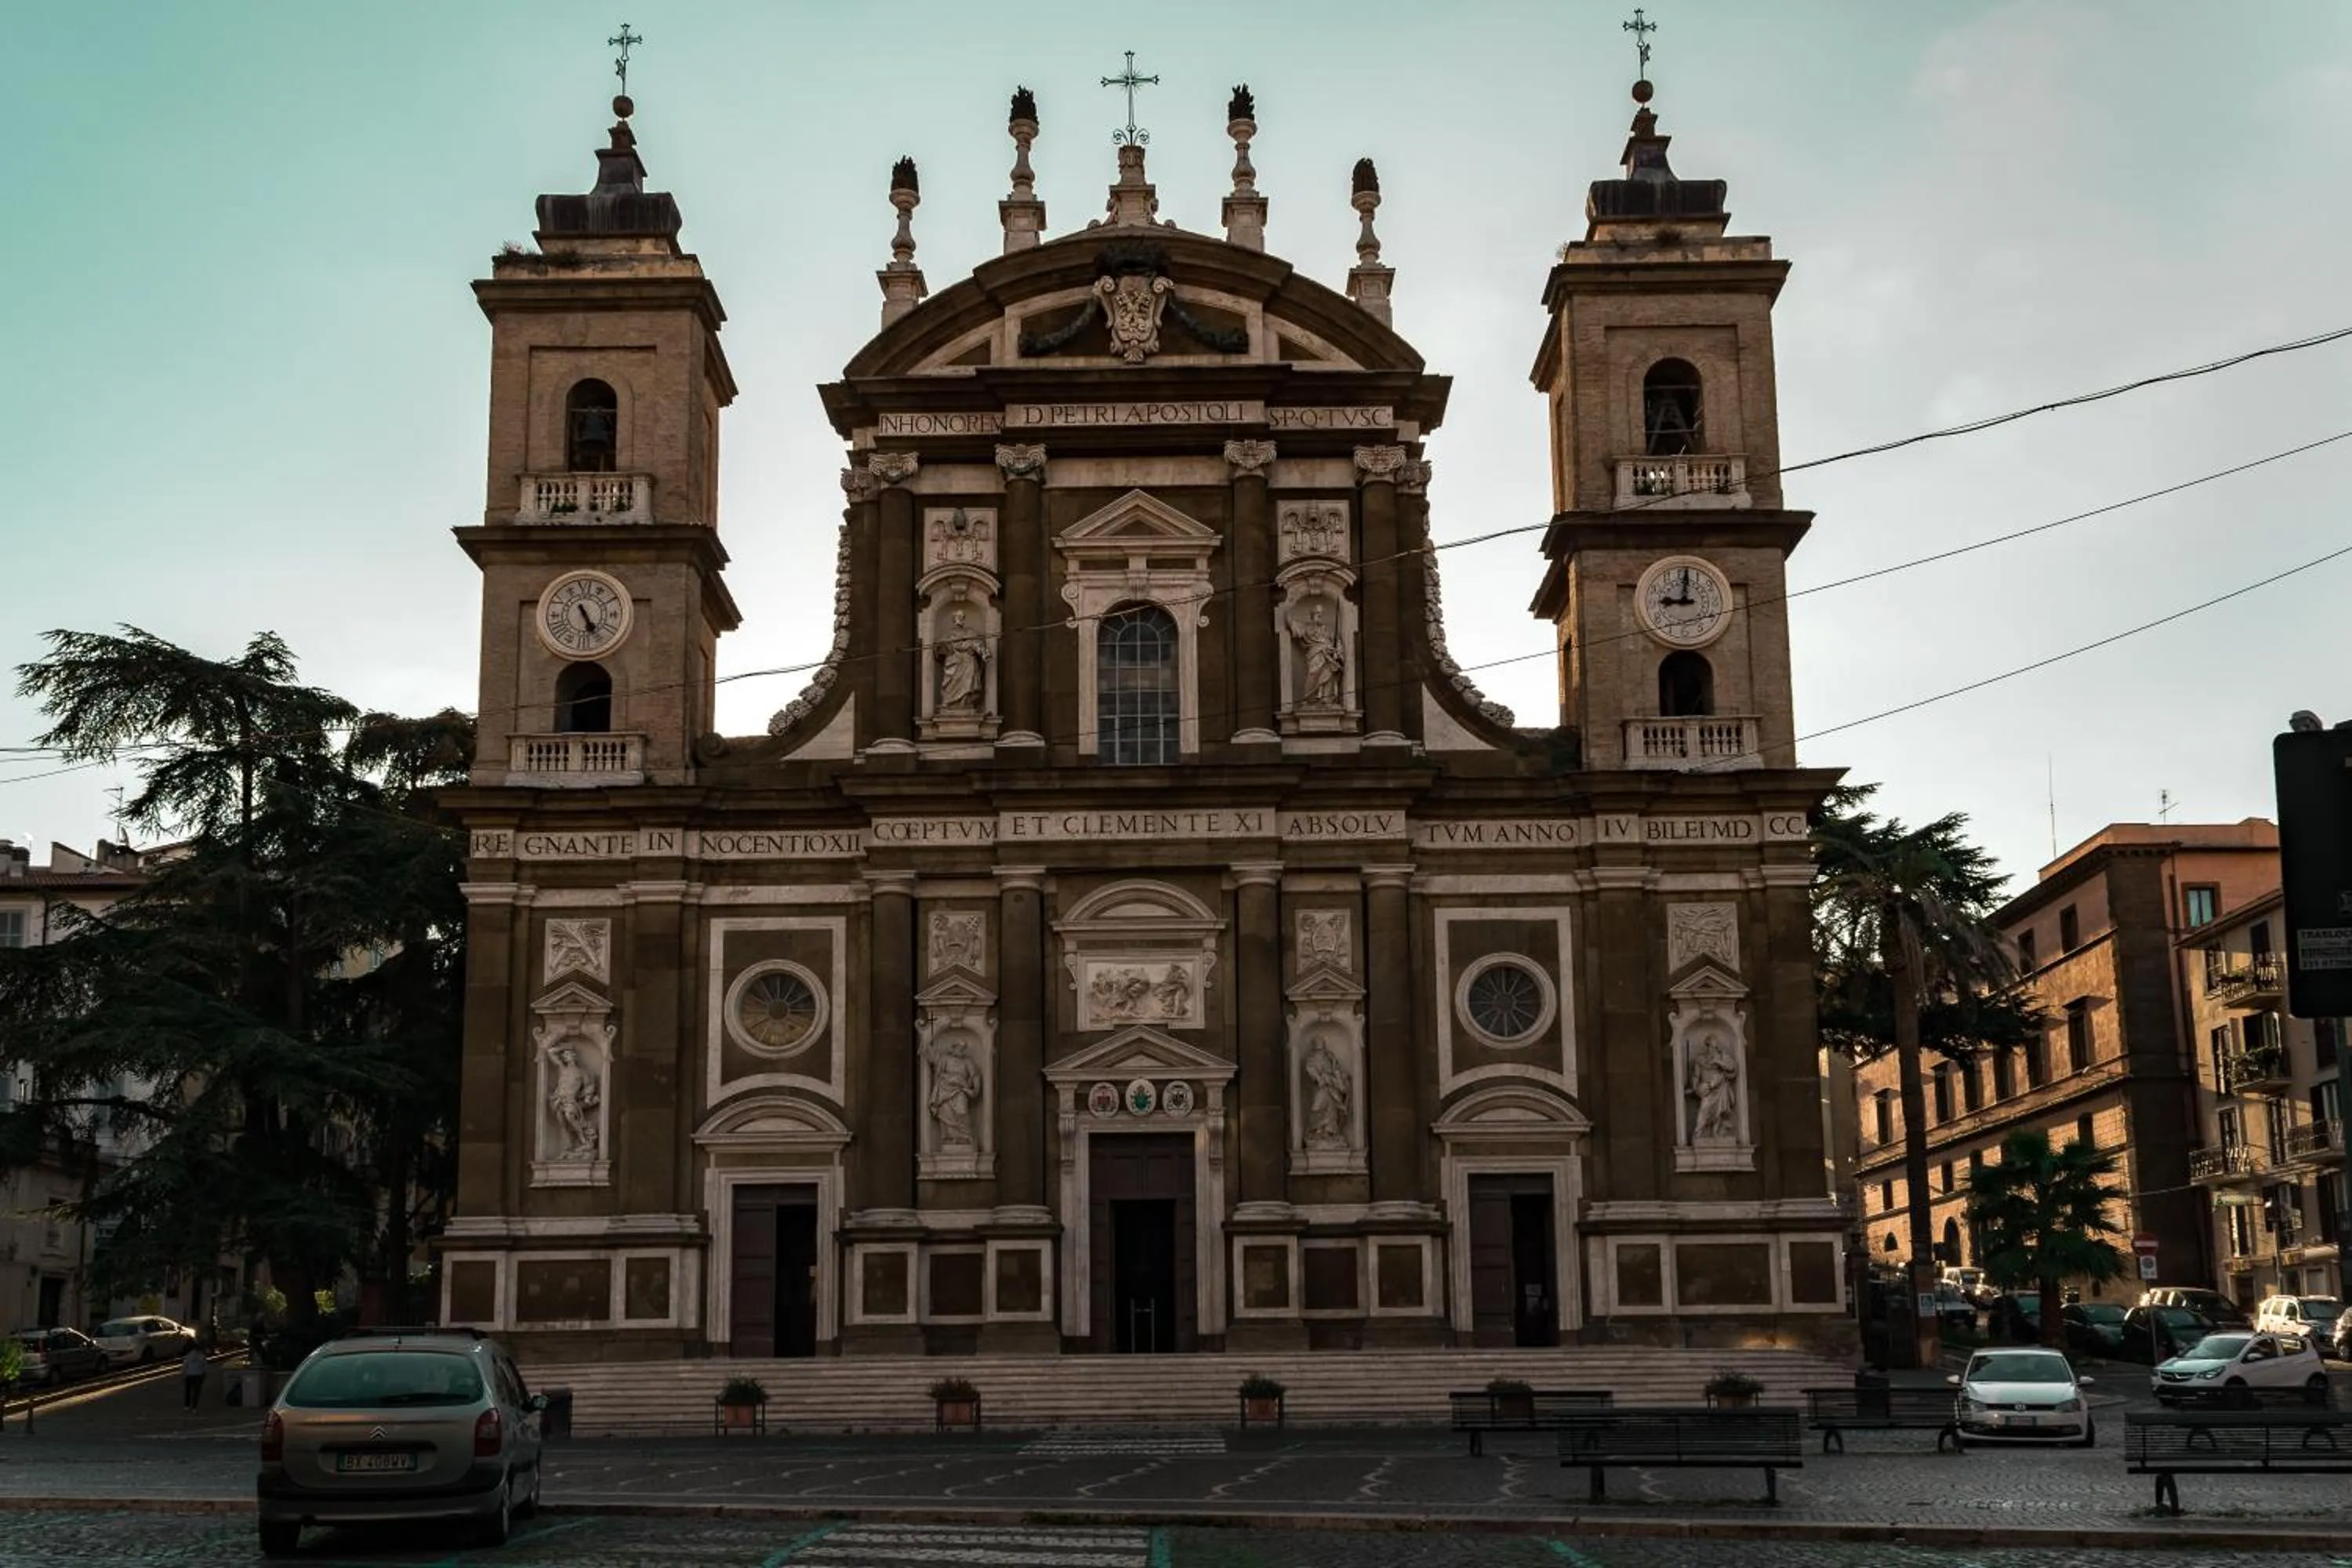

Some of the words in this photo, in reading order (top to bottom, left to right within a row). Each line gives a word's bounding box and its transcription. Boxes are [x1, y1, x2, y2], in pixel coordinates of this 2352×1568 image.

[1124, 402, 1244, 423] APOSTOLI
[1011, 815, 1049, 836] ET
[1062, 813, 1220, 835] CLEMENTE
[1233, 812, 1264, 832] XI
